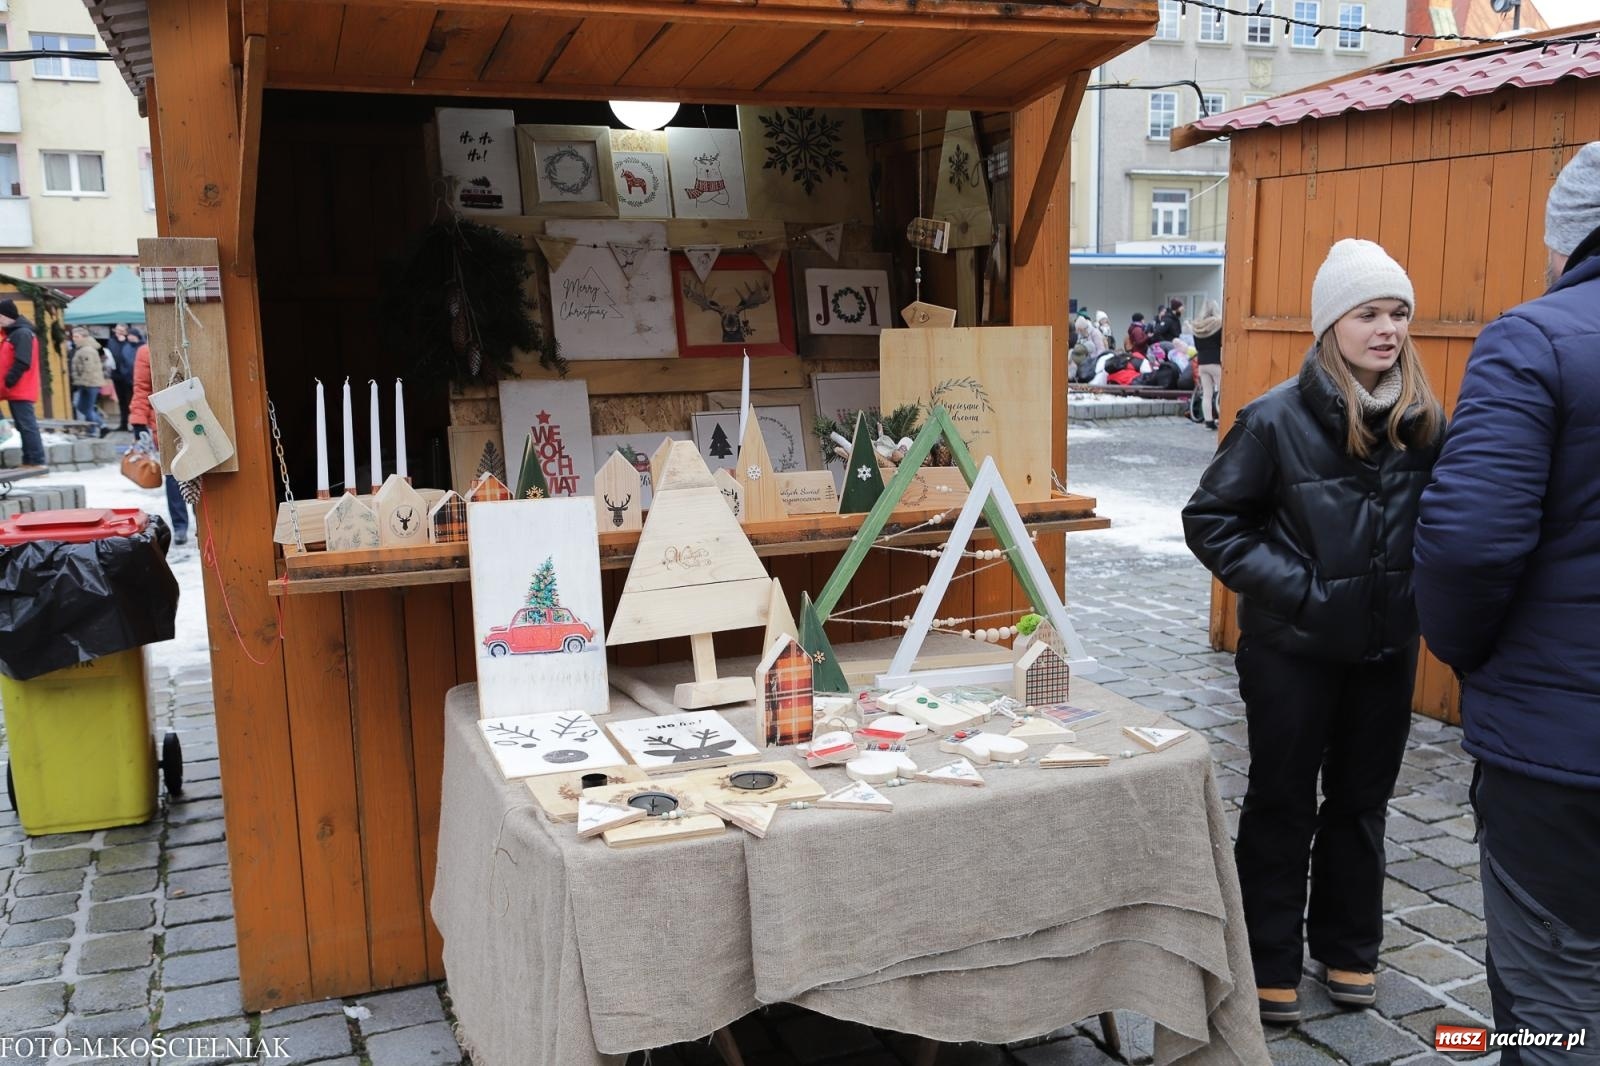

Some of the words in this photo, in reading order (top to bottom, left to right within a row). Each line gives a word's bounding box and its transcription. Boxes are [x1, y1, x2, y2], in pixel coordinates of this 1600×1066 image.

[50, 265, 114, 279] RESTA
[562, 278, 600, 302] Merry
[560, 301, 609, 322] Christmas
[816, 285, 880, 326] JOY
[531, 425, 561, 443] WE
[541, 457, 574, 476] CH
